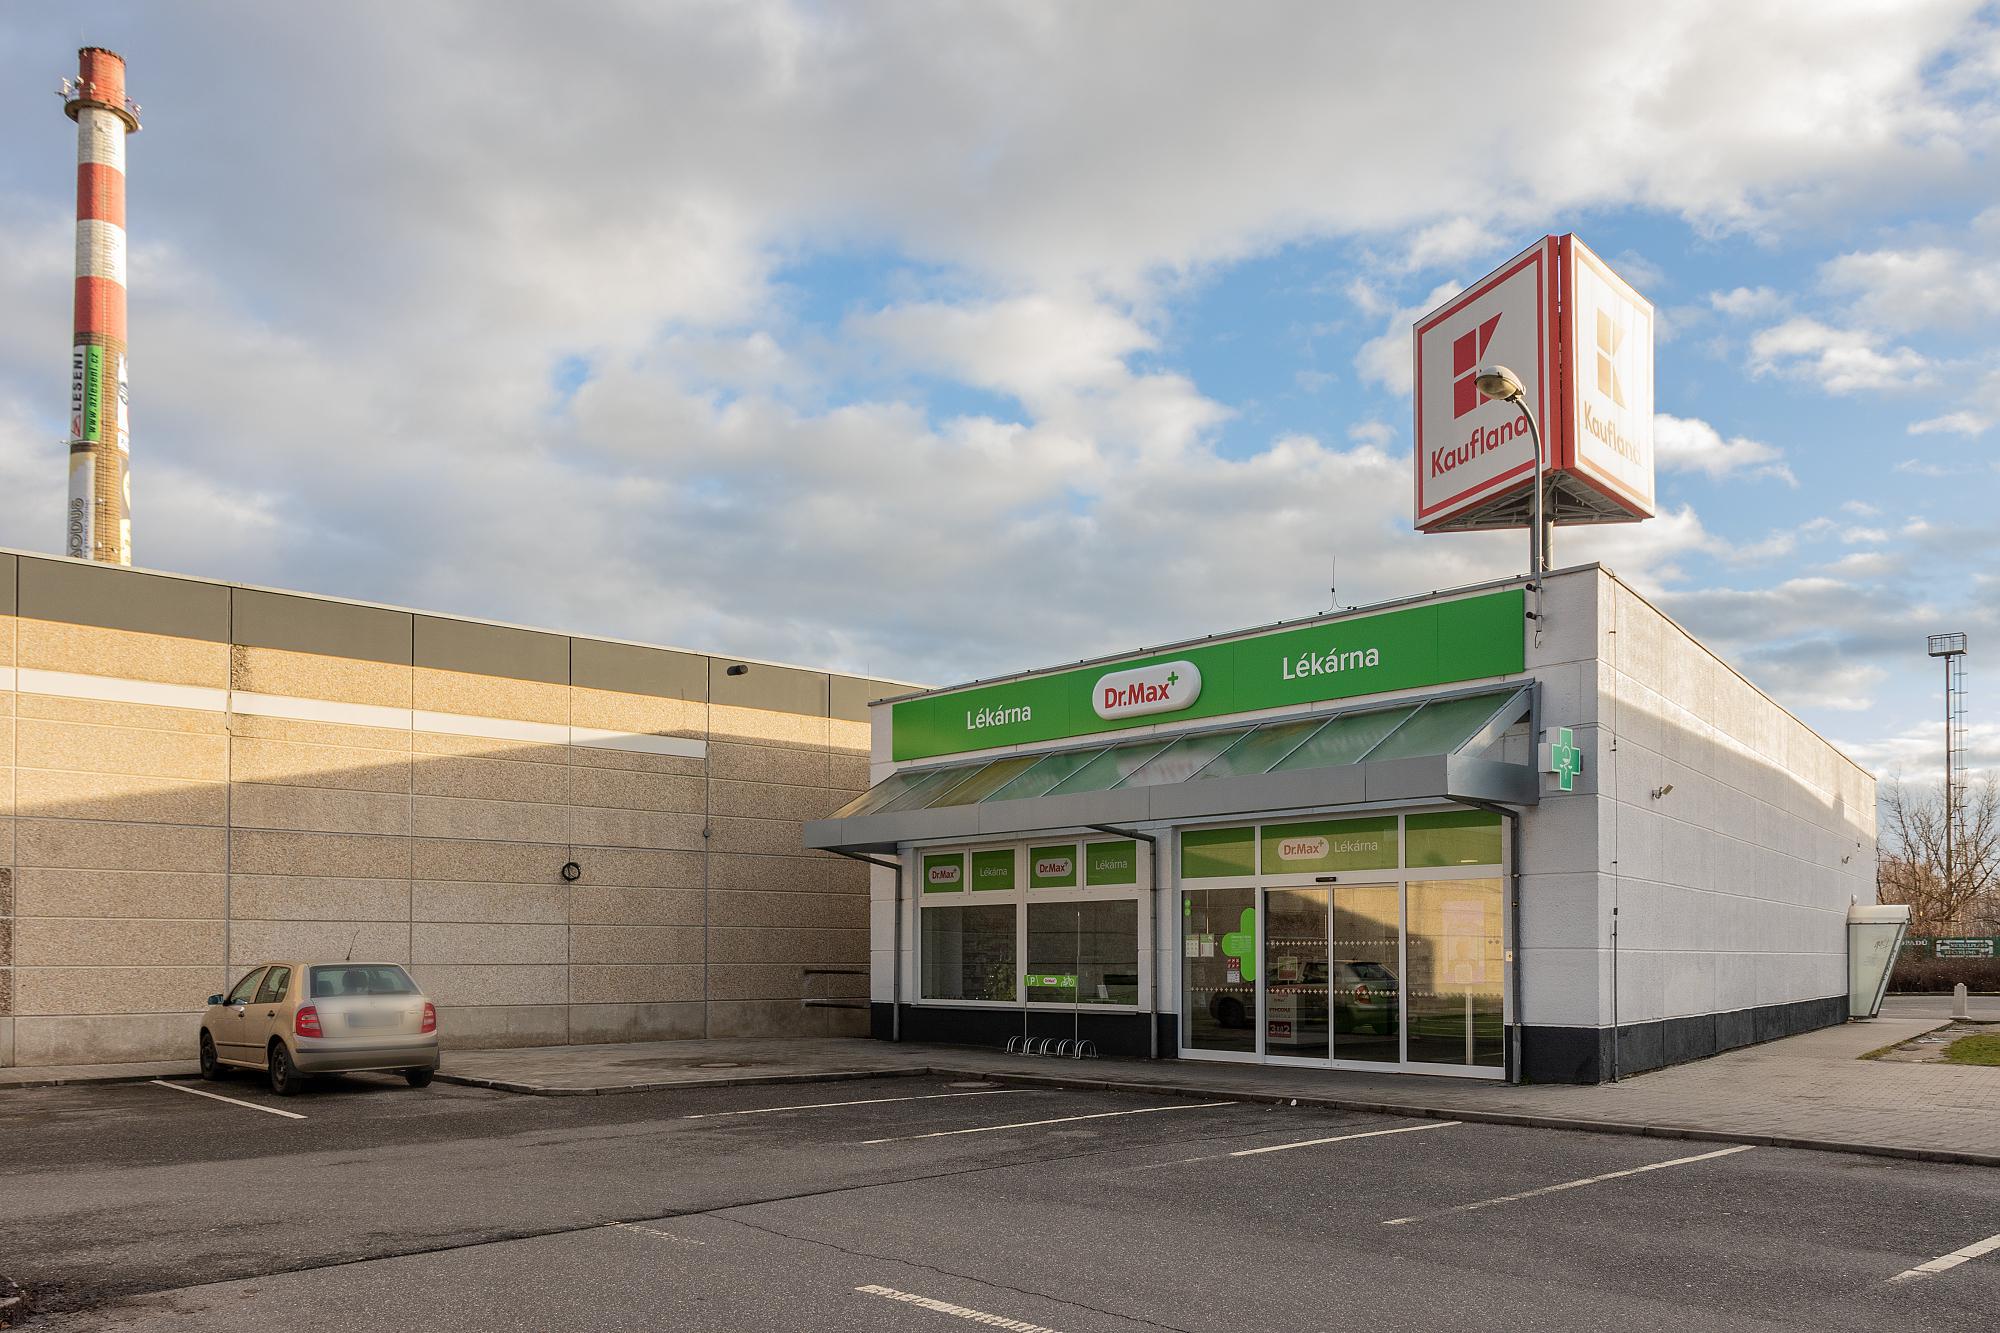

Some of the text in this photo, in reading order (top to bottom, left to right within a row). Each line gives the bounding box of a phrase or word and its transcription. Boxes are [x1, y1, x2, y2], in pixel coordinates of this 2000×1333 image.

[1584, 401, 1642, 467] Kaufland
[1282, 648, 1380, 681] Lékárna
[966, 703, 1032, 730] Lékárna
[1334, 840, 1378, 853] Lékárna
[979, 866, 1008, 877] Lékárna
[1095, 858, 1128, 870] Lékárna
